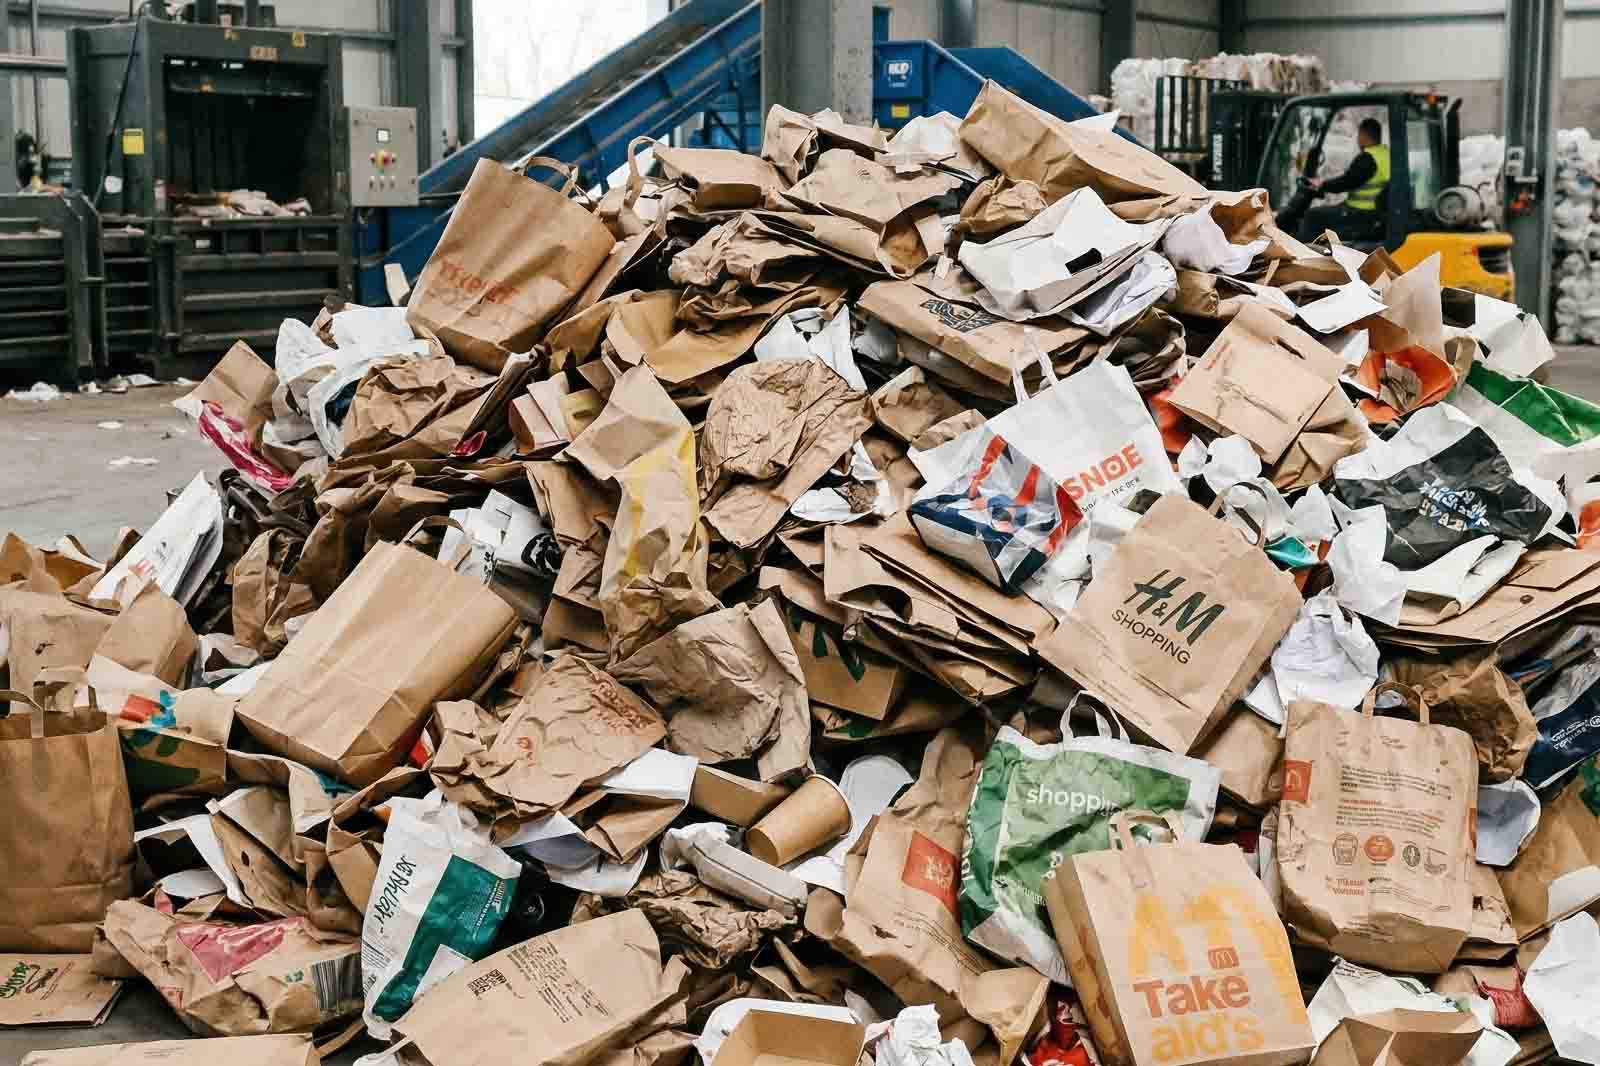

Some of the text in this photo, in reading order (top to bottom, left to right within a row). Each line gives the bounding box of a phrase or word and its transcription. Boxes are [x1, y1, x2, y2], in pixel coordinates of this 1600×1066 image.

[1123, 568, 1225, 646] H&M
[1111, 608, 1192, 664] SHOPPING
[1132, 975, 1250, 1018] Take
